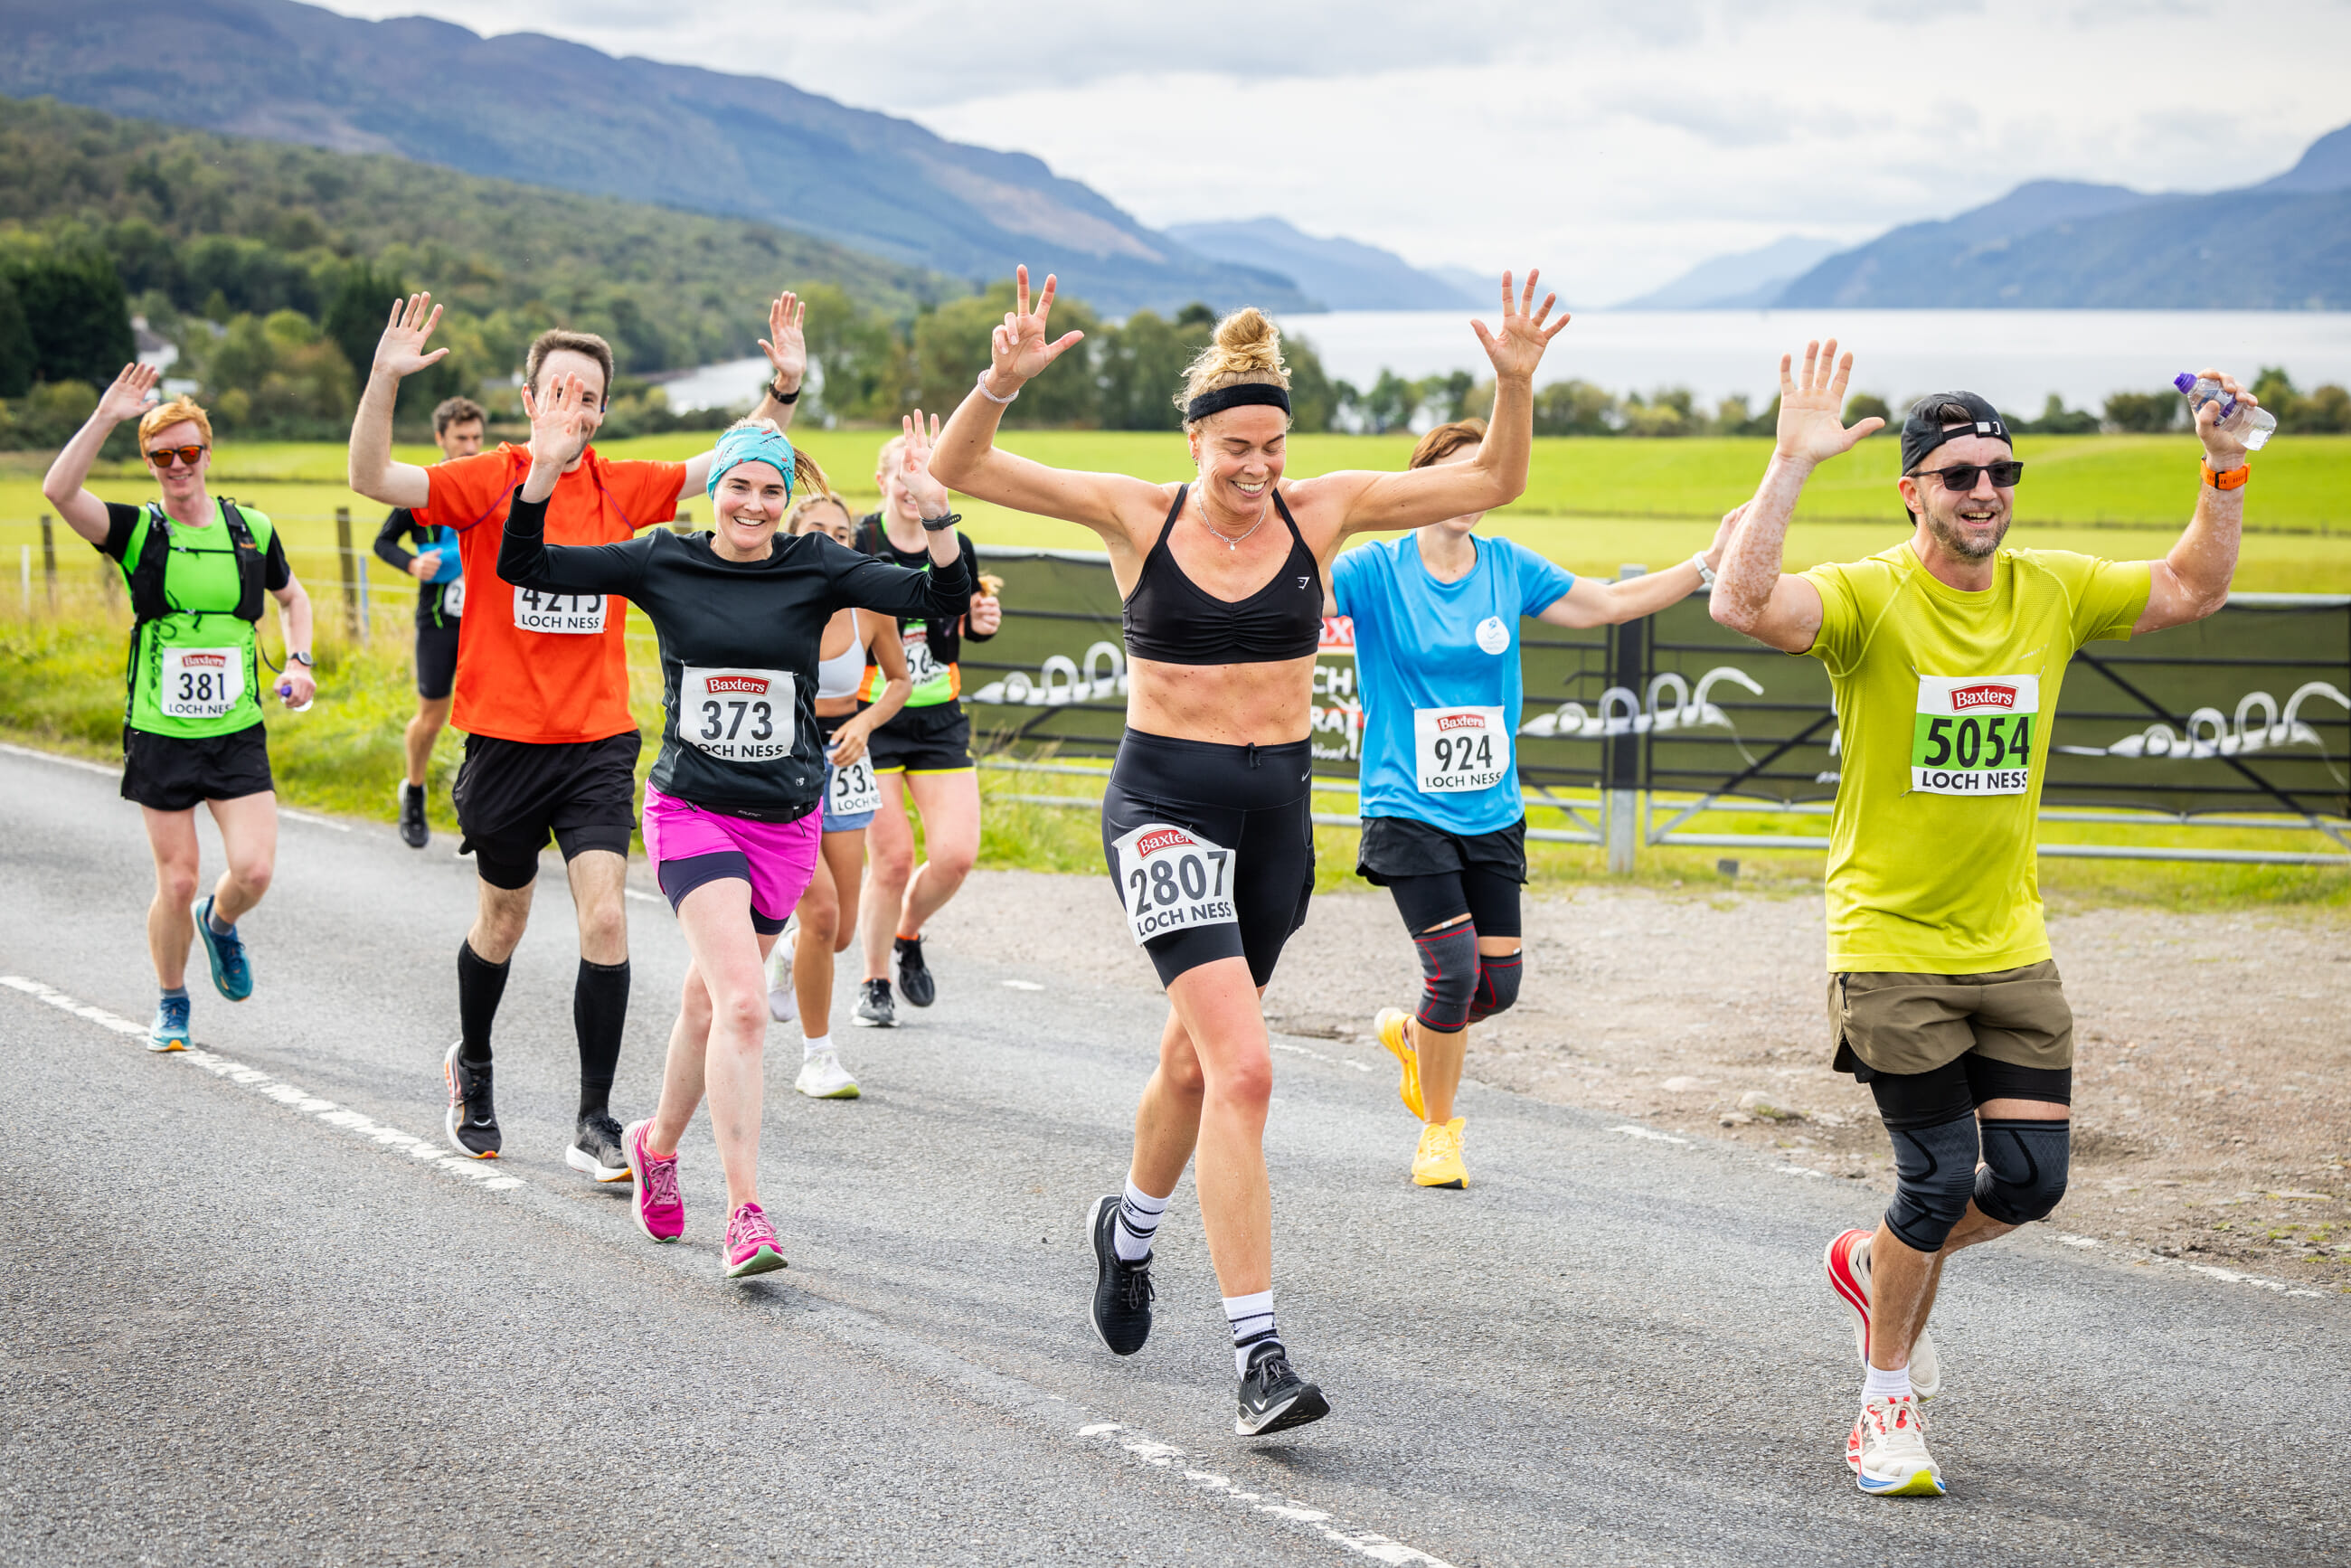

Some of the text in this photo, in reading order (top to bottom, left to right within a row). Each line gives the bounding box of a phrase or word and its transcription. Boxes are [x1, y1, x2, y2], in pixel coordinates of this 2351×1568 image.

[522, 614, 600, 629] LOCH NESS
[178, 673, 225, 701] 381
[709, 678, 766, 693] Baxters
[1956, 687, 2013, 707] Baxters
[169, 704, 231, 713] LOCH NES
[700, 700, 773, 741] 373
[1440, 715, 1485, 731] Baxters
[697, 743, 784, 758] OCH NESS
[1923, 716, 2030, 769] 5054
[1434, 734, 1493, 772] 924
[836, 764, 874, 798] 53
[1425, 772, 1502, 788] LOCH NESS
[1921, 770, 1979, 789] LOCH
[837, 798, 869, 811] LOCH
[1129, 850, 1228, 917] 2807
[1137, 902, 1232, 937] LOCH NESS
